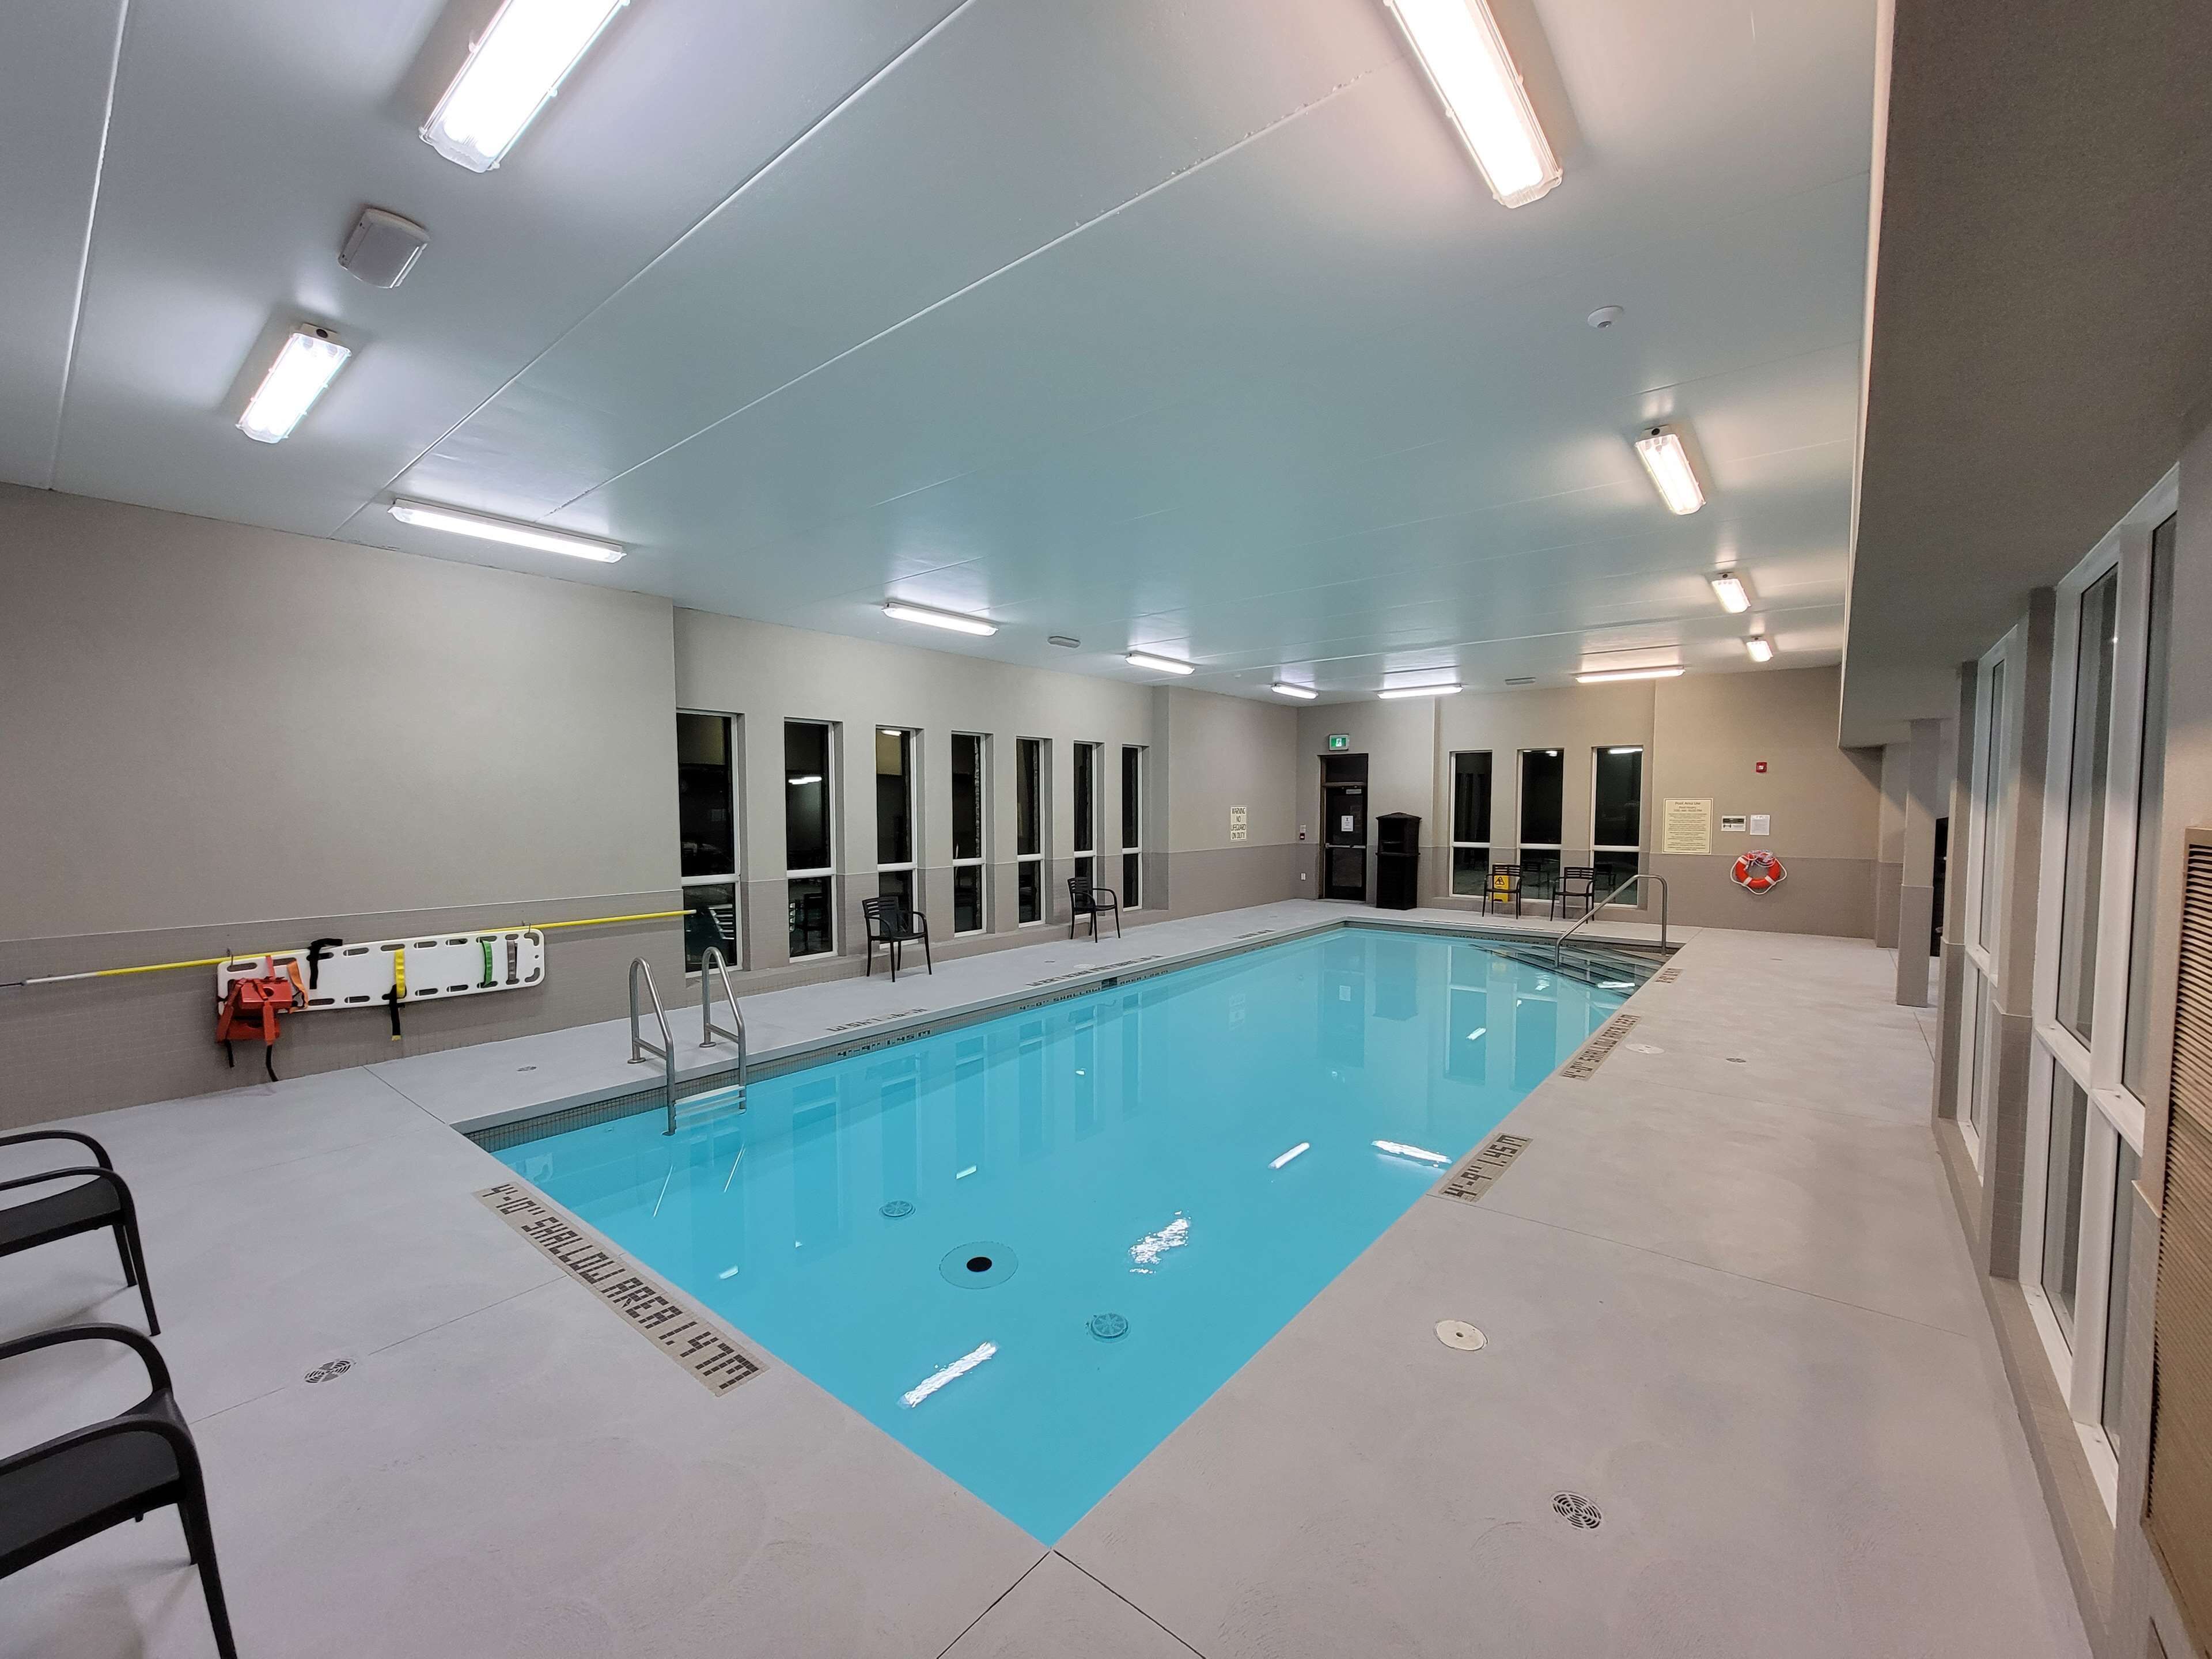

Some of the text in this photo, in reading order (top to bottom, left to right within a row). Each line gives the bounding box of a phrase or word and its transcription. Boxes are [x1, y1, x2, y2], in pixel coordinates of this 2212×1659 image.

[1052, 987, 1101, 1002] SHALLOW
[1578, 1037, 1618, 1063] SHALLOW
[521, 1217, 626, 1285] SHALLOW
[600, 1277, 684, 1330] AREA
